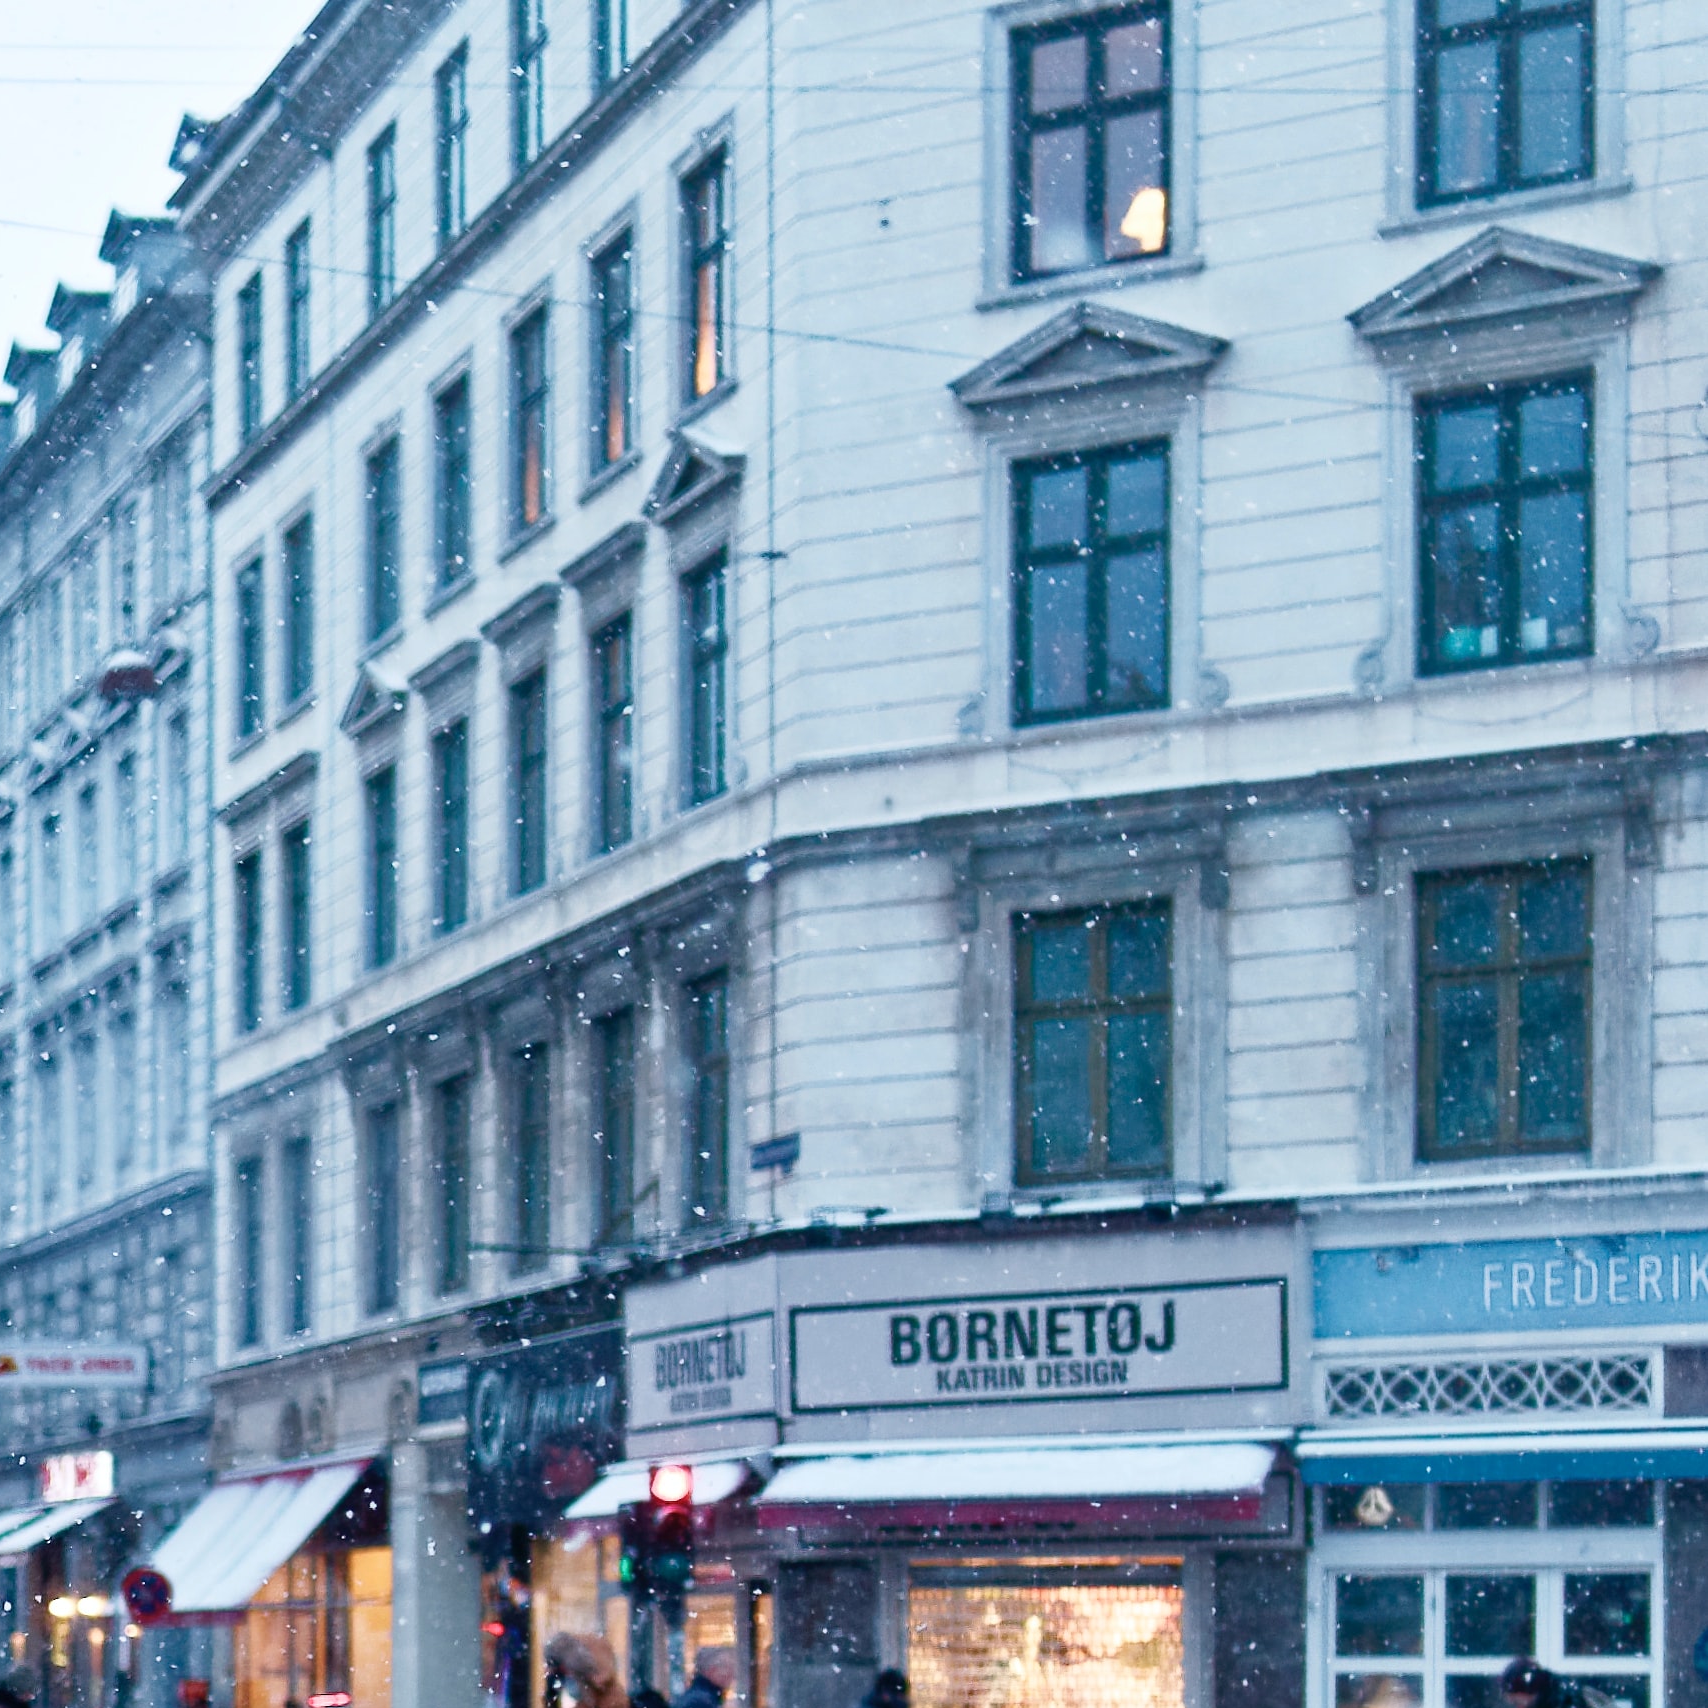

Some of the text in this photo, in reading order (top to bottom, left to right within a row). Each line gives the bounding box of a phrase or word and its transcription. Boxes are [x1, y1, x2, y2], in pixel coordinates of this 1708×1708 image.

[1483, 1252, 1708, 1312] FREDERIK
[889, 1299, 1177, 1366] BØRNETØJ
[936, 1359, 1129, 1393] KATRIN DESIGN
